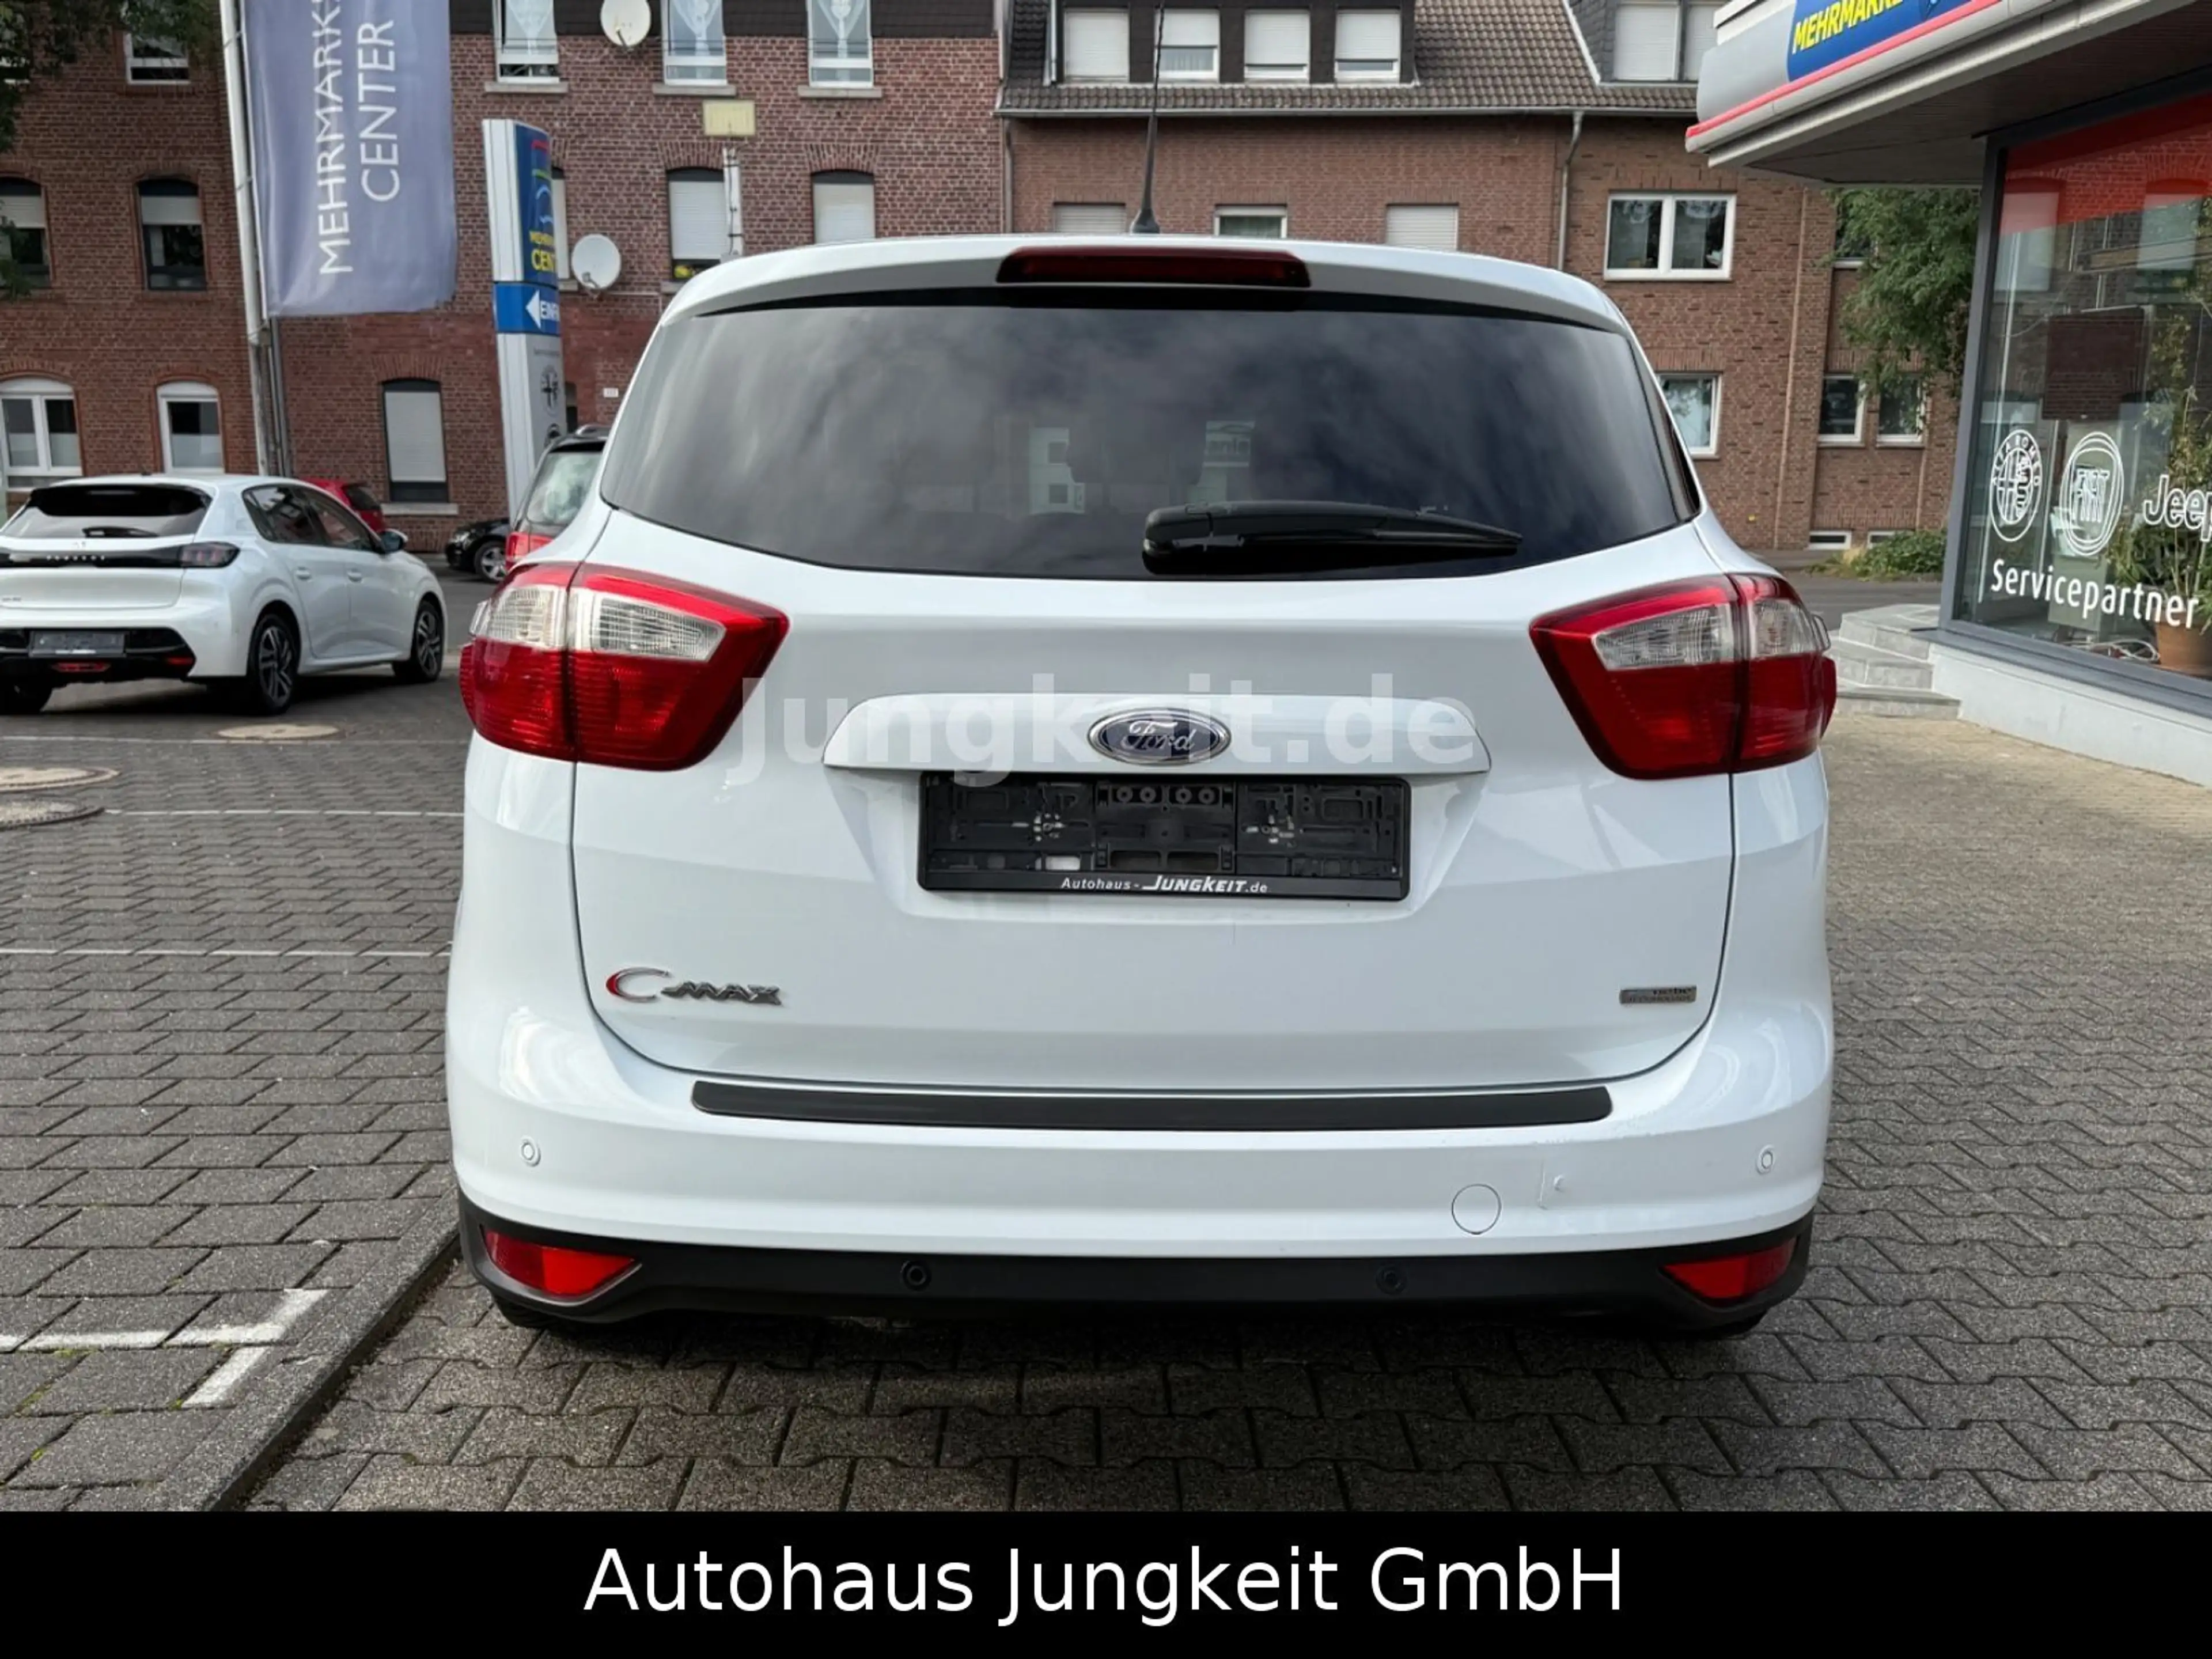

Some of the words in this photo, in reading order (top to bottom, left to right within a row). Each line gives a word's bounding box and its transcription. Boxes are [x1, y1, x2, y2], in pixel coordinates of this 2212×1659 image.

[1792, 0, 1903, 54] MEHRMAR
[311, 0, 353, 274] MEHRMARK
[358, 20, 400, 201] CENTER
[1991, 559, 2199, 629] Servicepartner
[1120, 720, 1196, 750] Ford
